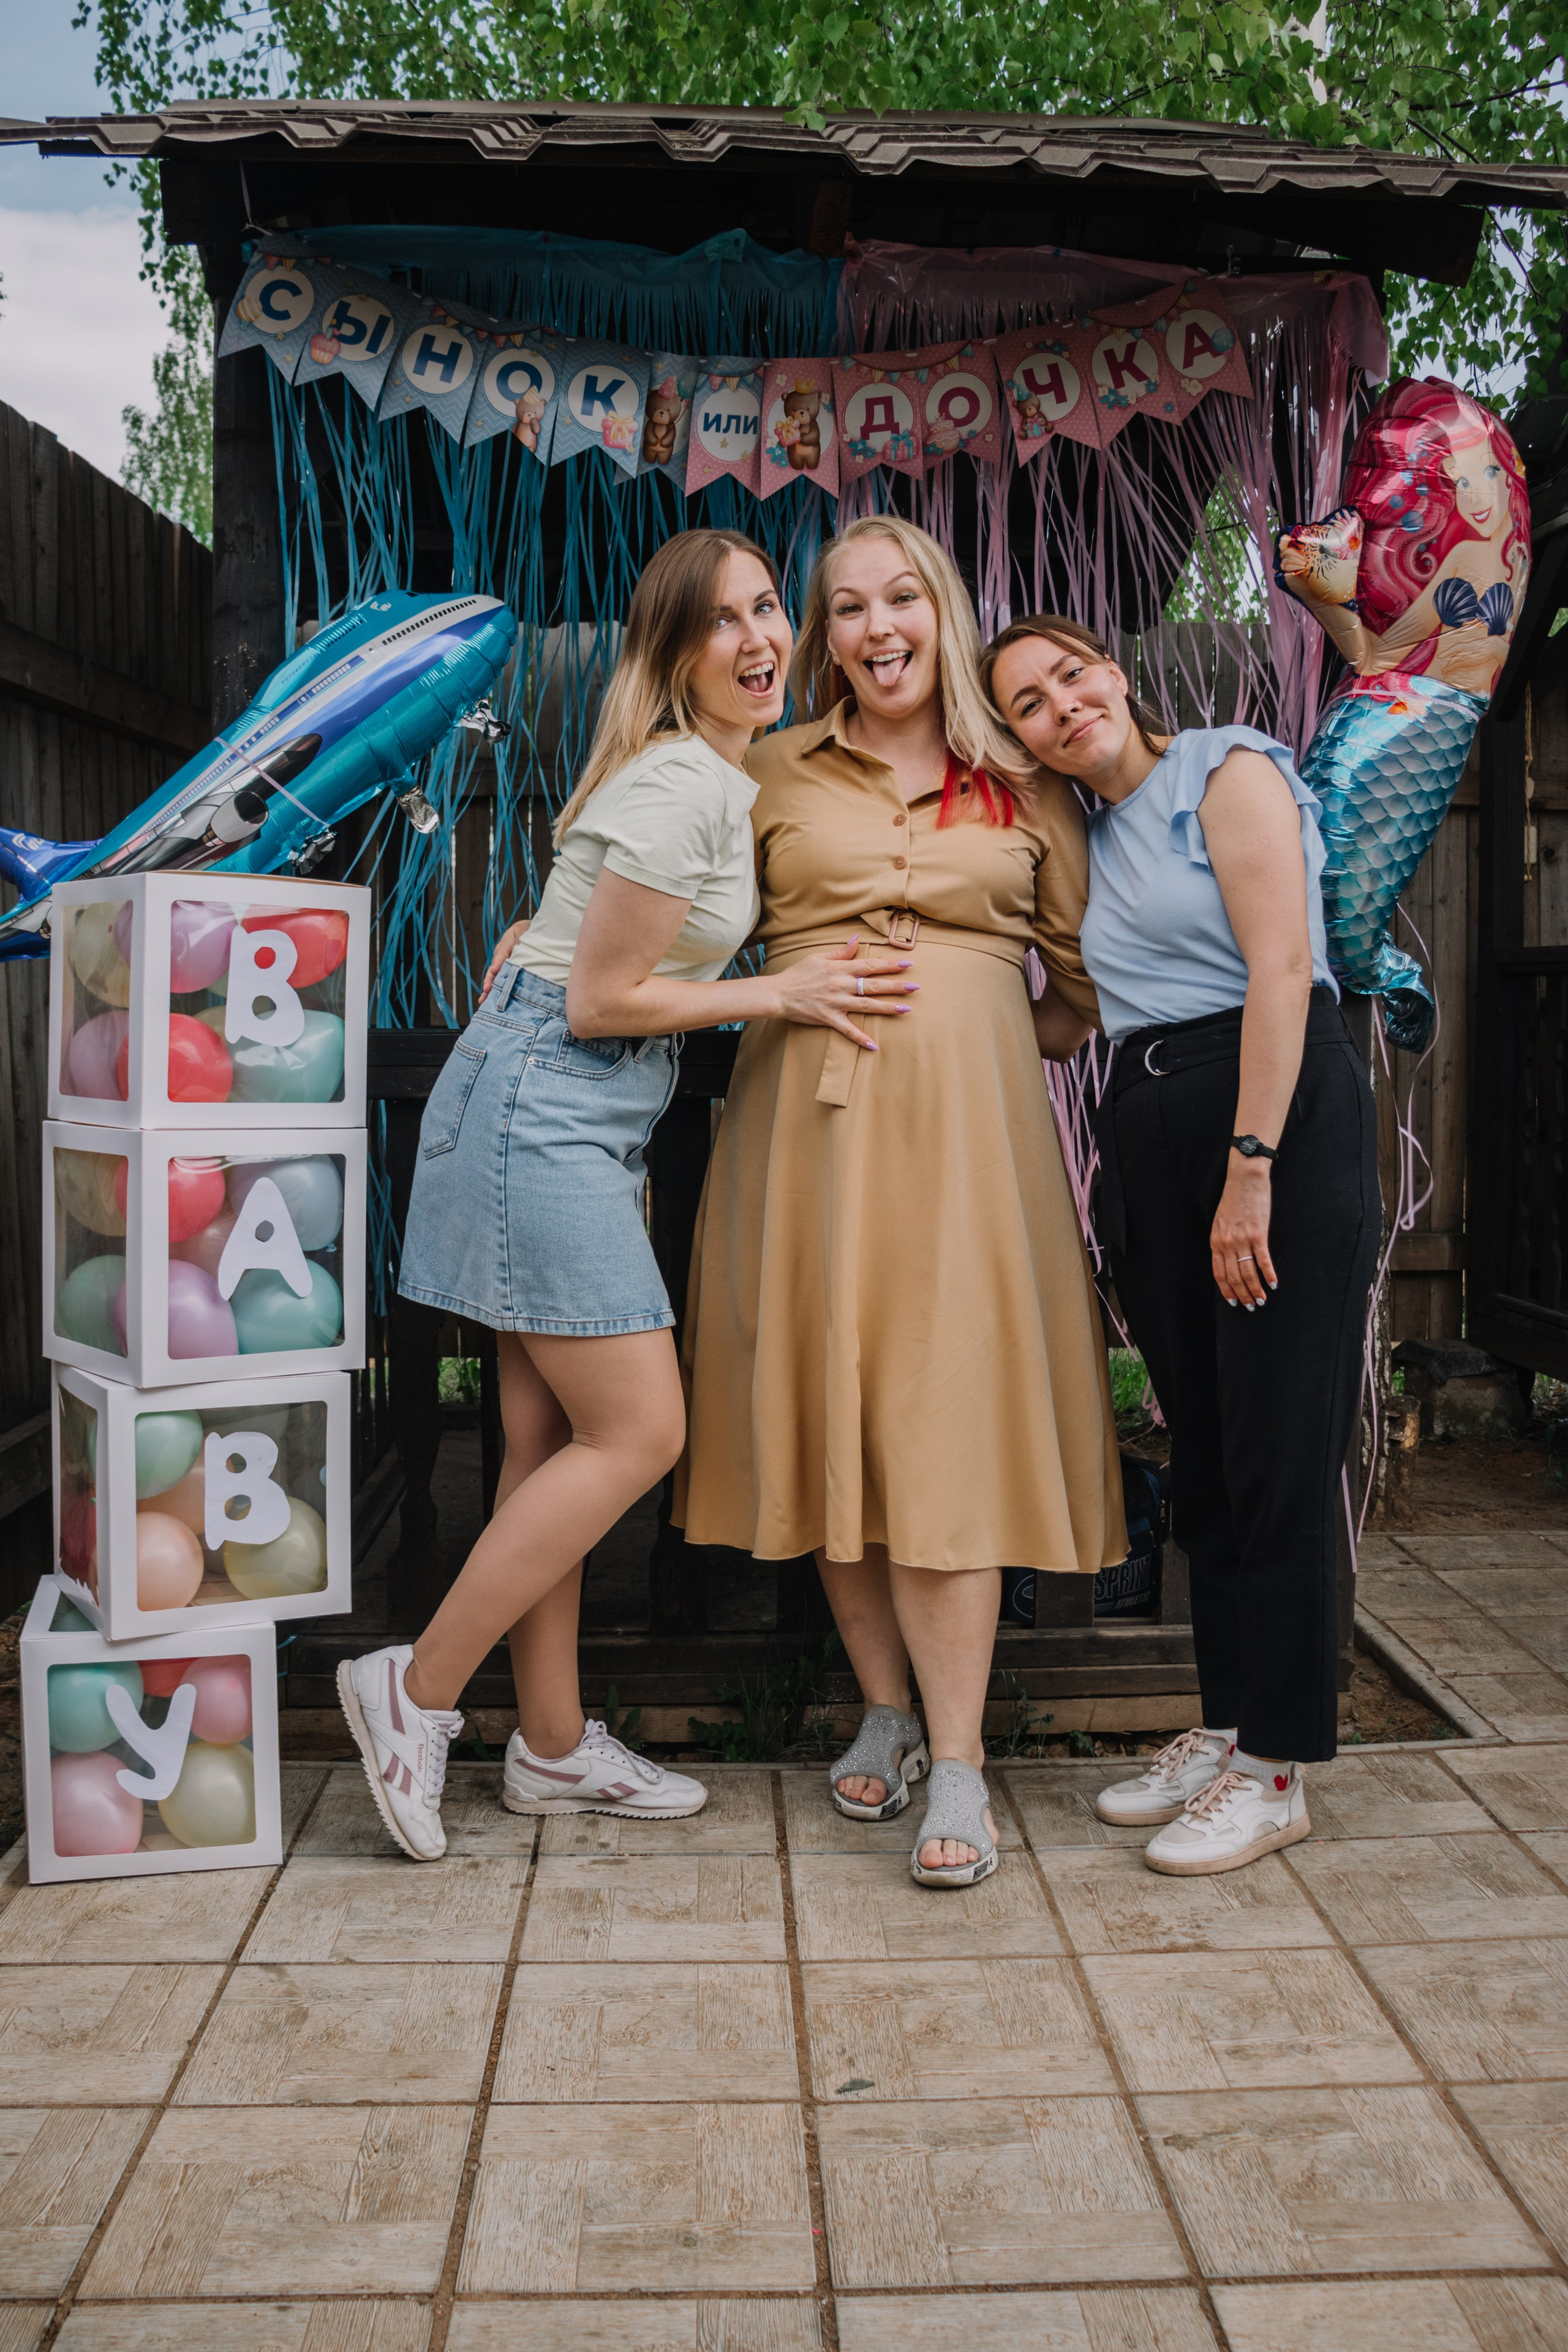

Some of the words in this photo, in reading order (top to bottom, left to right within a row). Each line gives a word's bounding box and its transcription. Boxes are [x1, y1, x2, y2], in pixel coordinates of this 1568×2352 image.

[258, 279, 626, 417] СЫНОК
[703, 412, 758, 435] ИЛИ
[859, 322, 1224, 440] ДОЧКА
